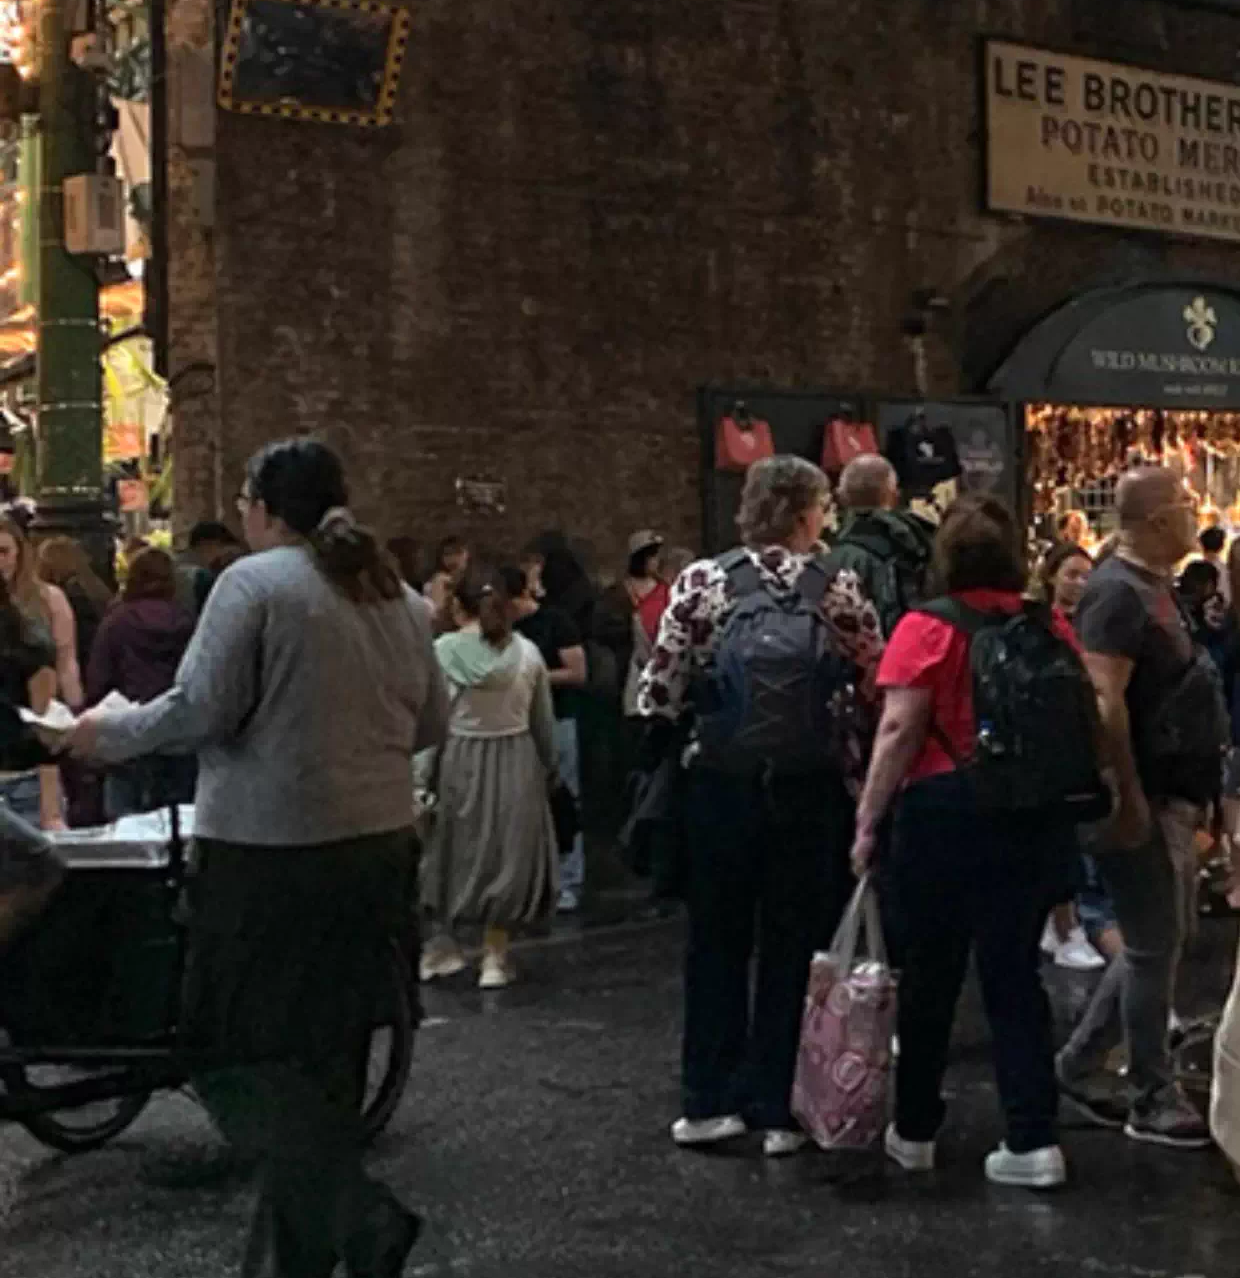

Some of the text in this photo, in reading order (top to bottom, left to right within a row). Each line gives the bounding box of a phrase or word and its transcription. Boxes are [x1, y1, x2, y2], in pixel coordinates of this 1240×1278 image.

[994, 56, 1065, 105] LEE
[1041, 115, 1159, 162] POTATO
[1096, 194, 1173, 223] POTATO
